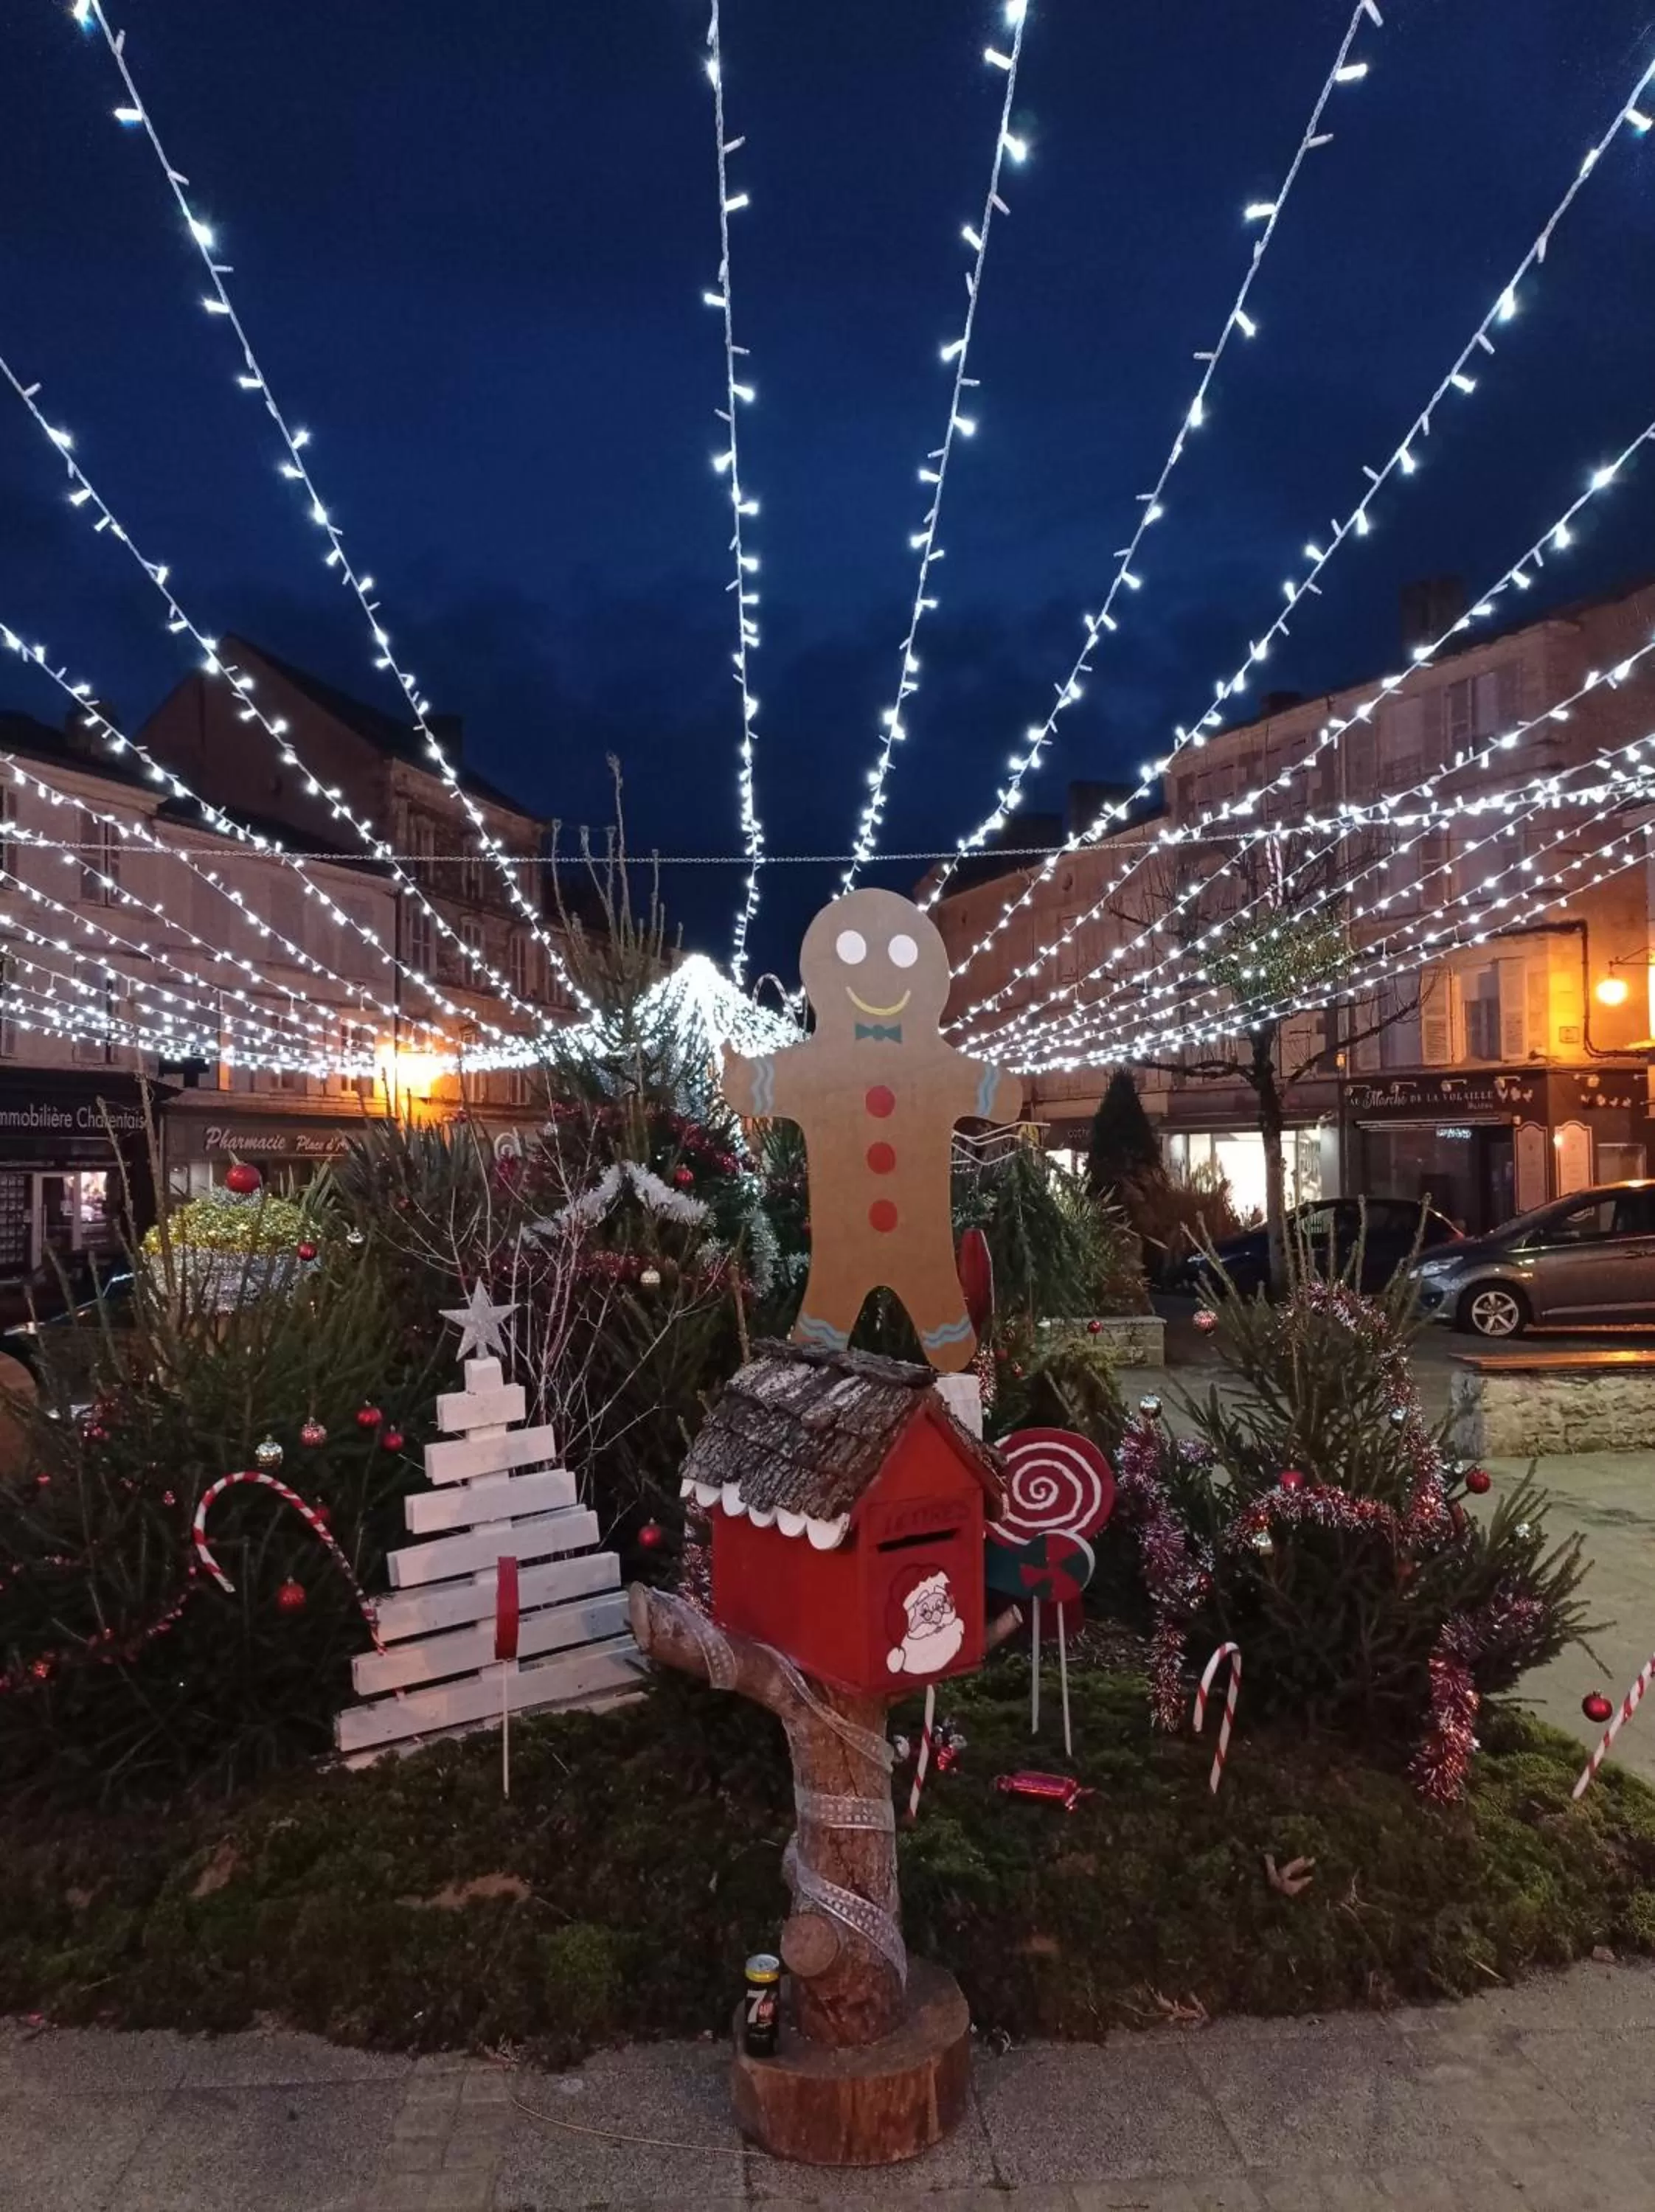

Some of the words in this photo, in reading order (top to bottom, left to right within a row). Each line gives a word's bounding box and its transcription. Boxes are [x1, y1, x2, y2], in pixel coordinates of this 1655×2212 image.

[1409, 1094, 1422, 1104] DE
[1426, 1093, 1440, 1103] LA
[1443, 1091, 1494, 1102] VOLAILLE
[206, 1126, 285, 1150] Pharmacie
